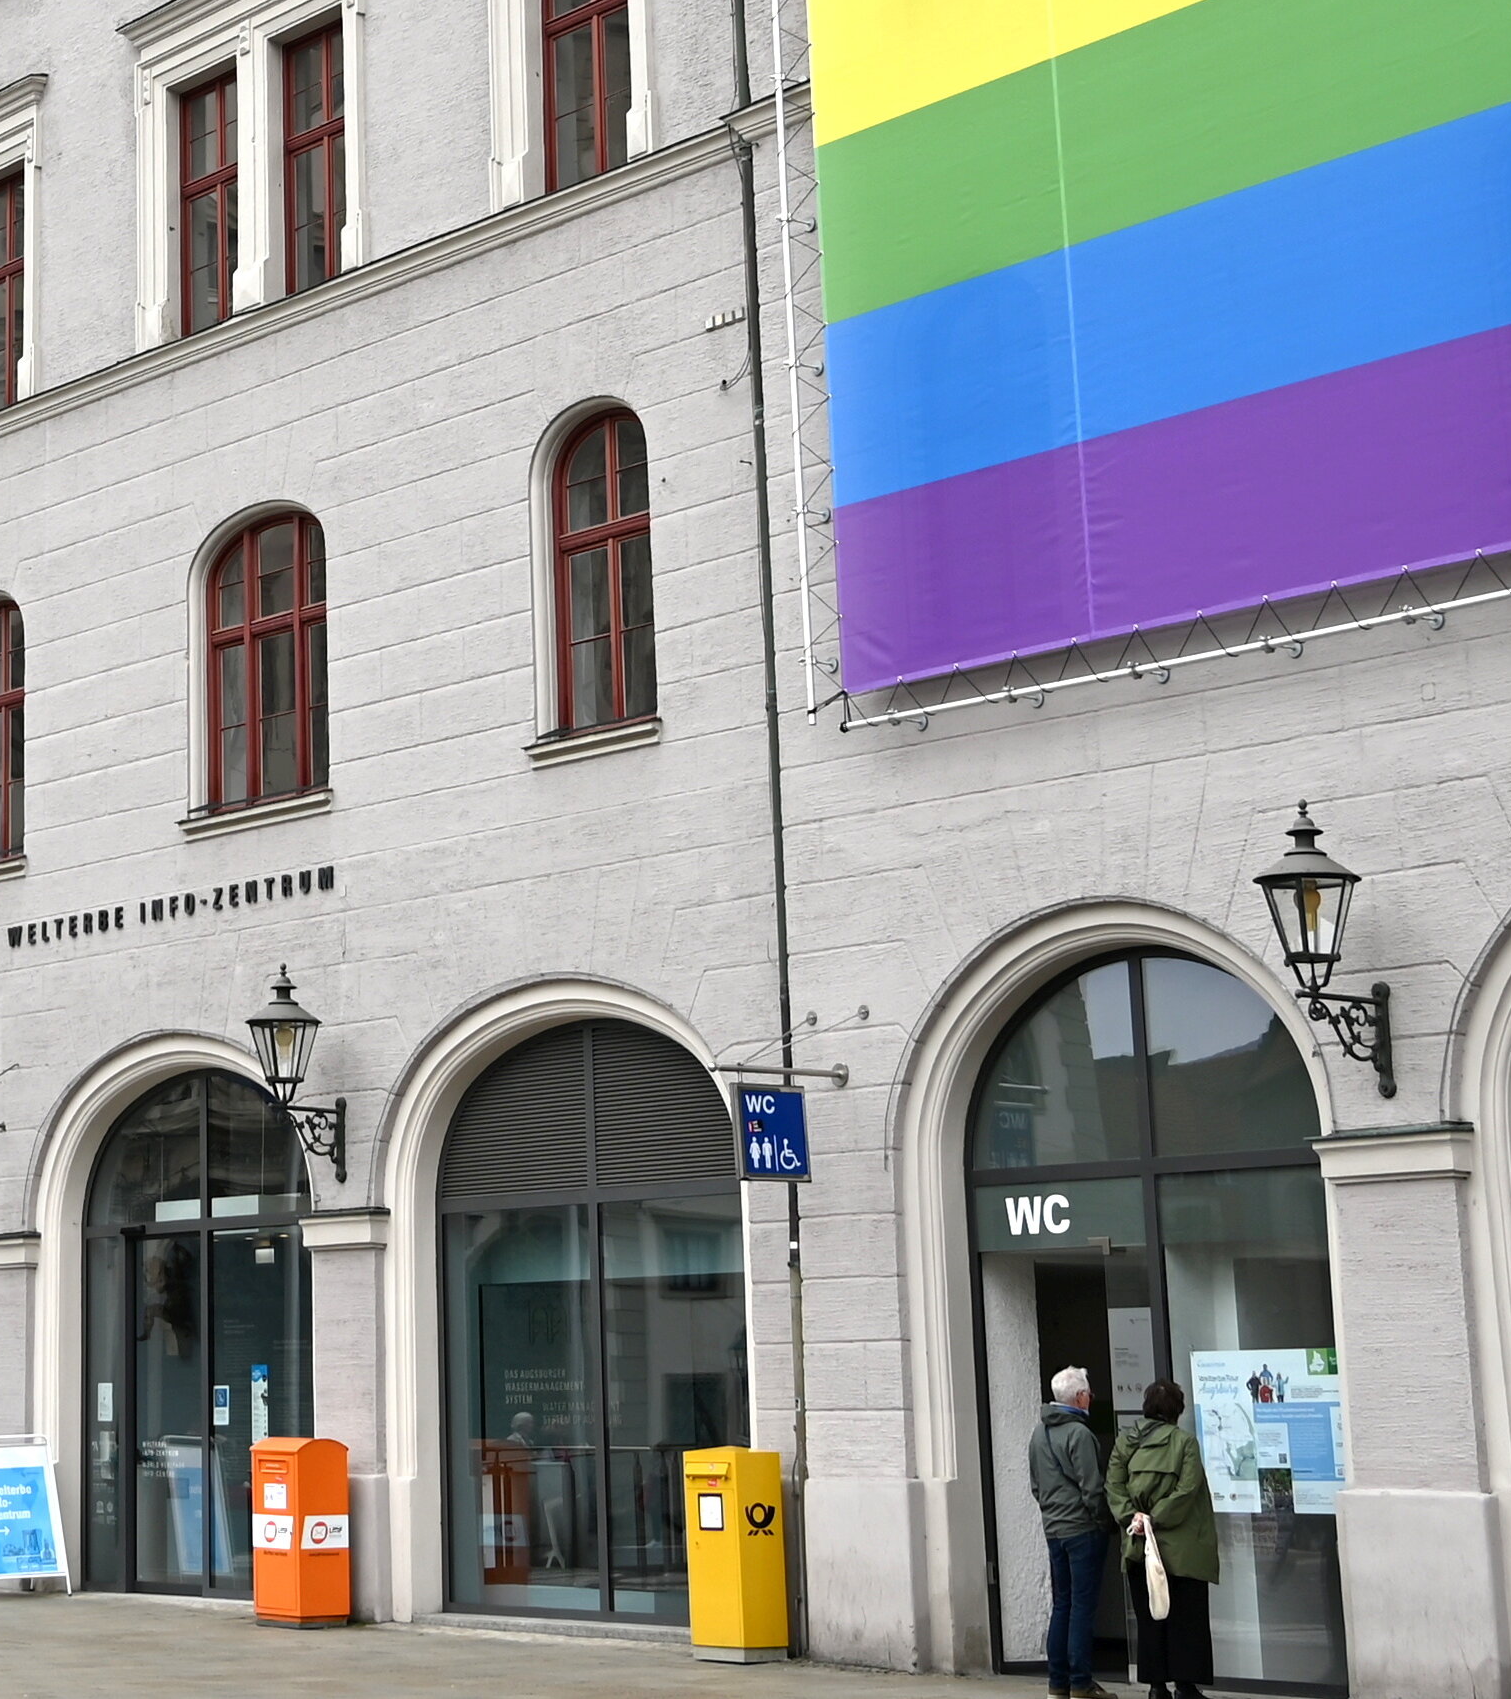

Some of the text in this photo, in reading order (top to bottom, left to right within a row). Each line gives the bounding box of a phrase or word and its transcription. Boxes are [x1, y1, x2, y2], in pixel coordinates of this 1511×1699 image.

[7, 866, 334, 948] WELTERBE INFO-ZENTRUM
[745, 1094, 776, 1114] WC
[1005, 1193, 1071, 1236] WC
